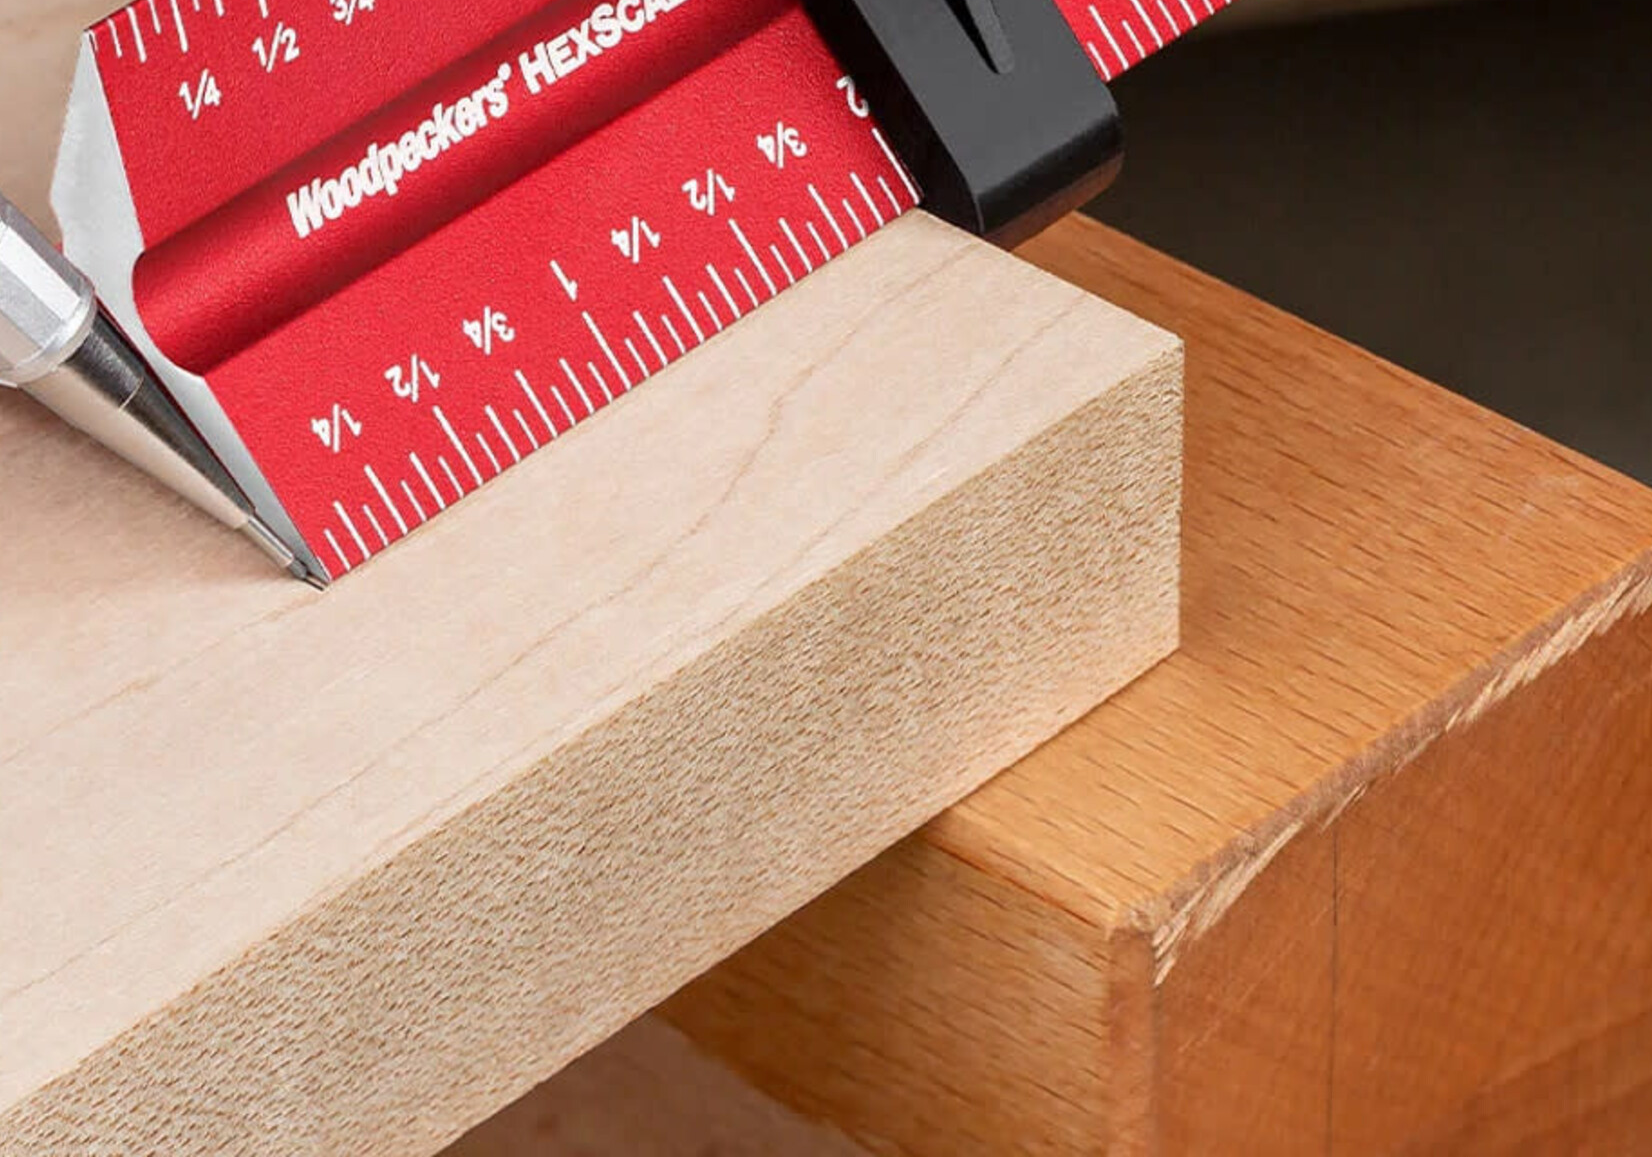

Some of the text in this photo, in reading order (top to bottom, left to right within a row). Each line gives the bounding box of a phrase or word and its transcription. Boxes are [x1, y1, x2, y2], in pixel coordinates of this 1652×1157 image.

[179, 69, 222, 119] 1/4
[252, 22, 300, 72] 1/2
[311, 76, 868, 453] 2 3/4 1/2 1/4 1 3/4 1/2 1/4
